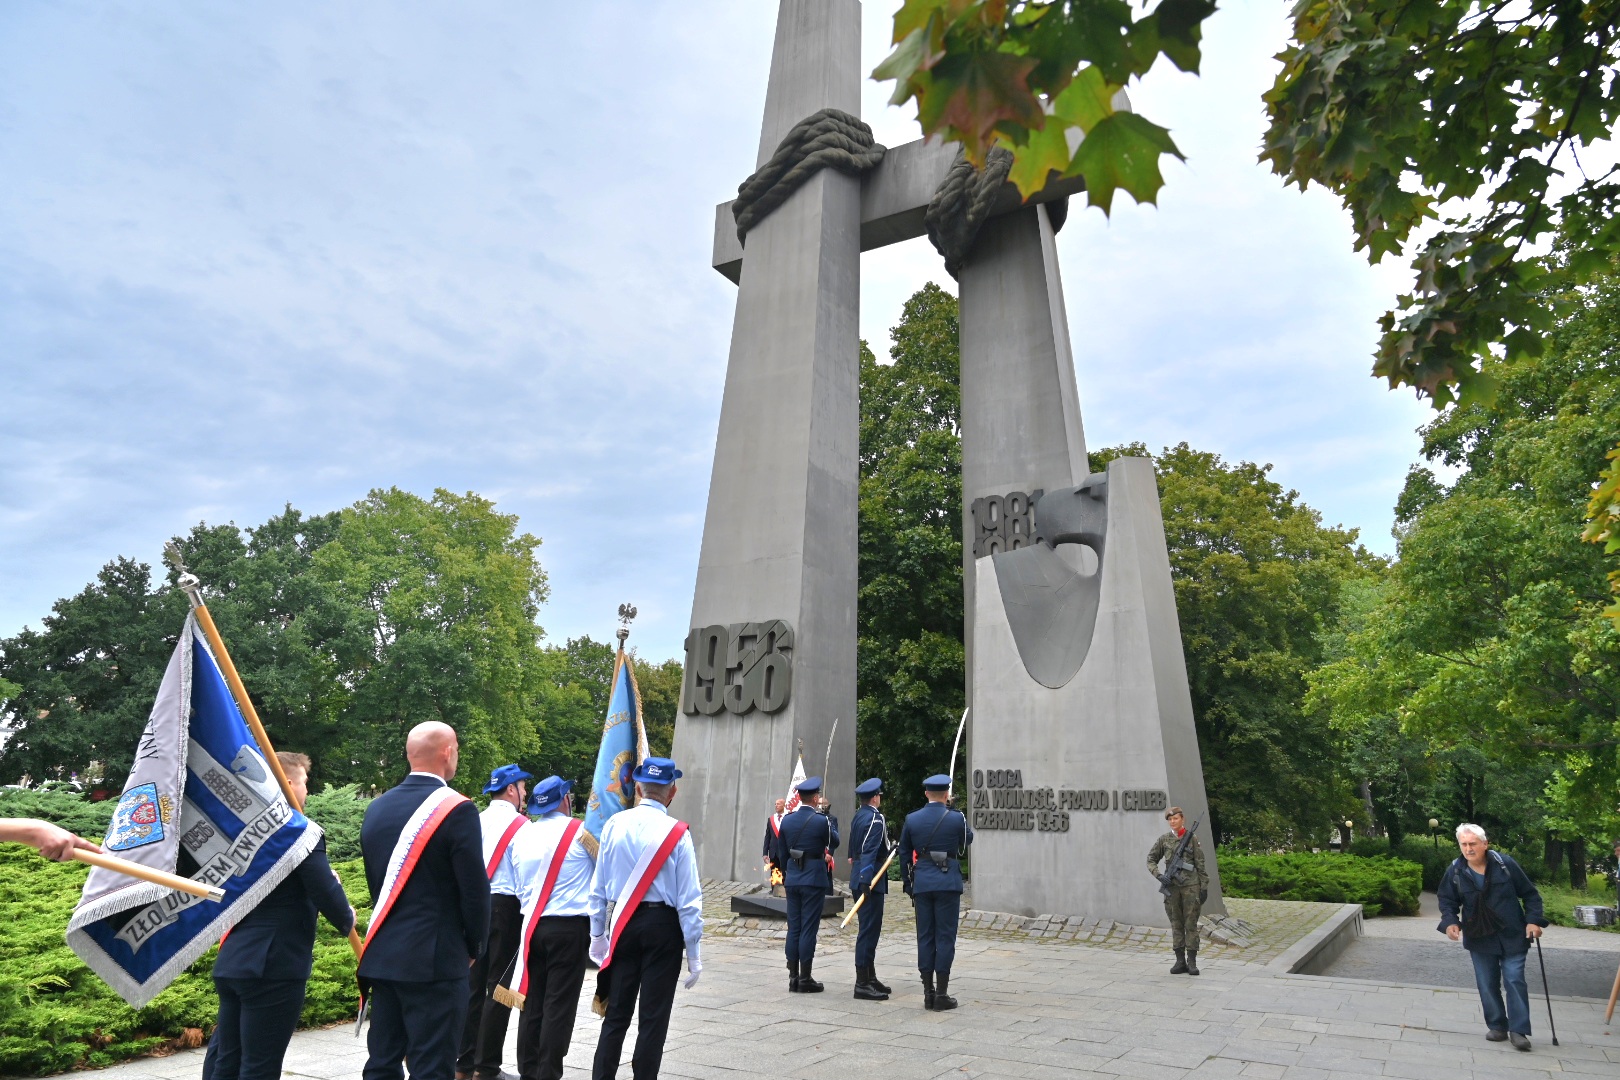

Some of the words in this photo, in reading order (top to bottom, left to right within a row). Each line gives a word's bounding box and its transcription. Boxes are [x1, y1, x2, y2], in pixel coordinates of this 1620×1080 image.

[684, 619, 794, 717] 1956
[973, 769, 984, 788] O
[986, 769, 1023, 789] BOGA
[973, 790, 989, 809] ZA
[992, 788, 1057, 812] WOLNOŚĆ,
[1058, 790, 1109, 811] PRAWO
[1112, 790, 1119, 810] I
[1121, 790, 1167, 811] CHLEB
[973, 810, 1034, 831] CZERWIEC
[1036, 811, 1070, 832] 1956
[181, 819, 215, 852] 1956
[125, 909, 163, 943] ZŁO
